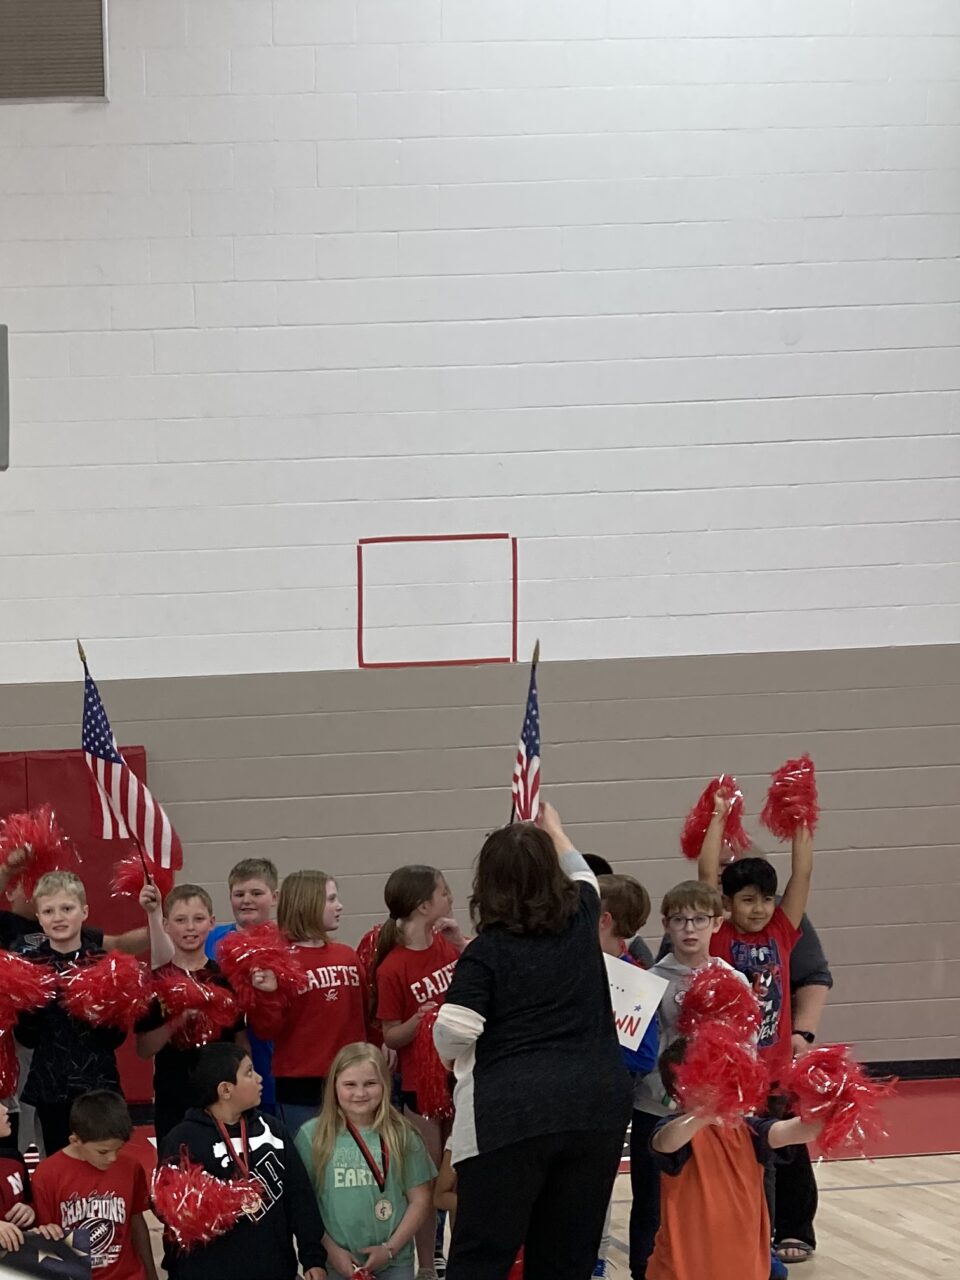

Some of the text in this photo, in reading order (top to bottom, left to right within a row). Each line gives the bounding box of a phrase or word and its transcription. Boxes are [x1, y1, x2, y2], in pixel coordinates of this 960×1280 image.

[410, 960, 458, 1003] CADE
[6, 1171, 23, 1196] N
[334, 1167, 378, 1188] EART
[60, 1196, 126, 1228] CHAMPIONS
